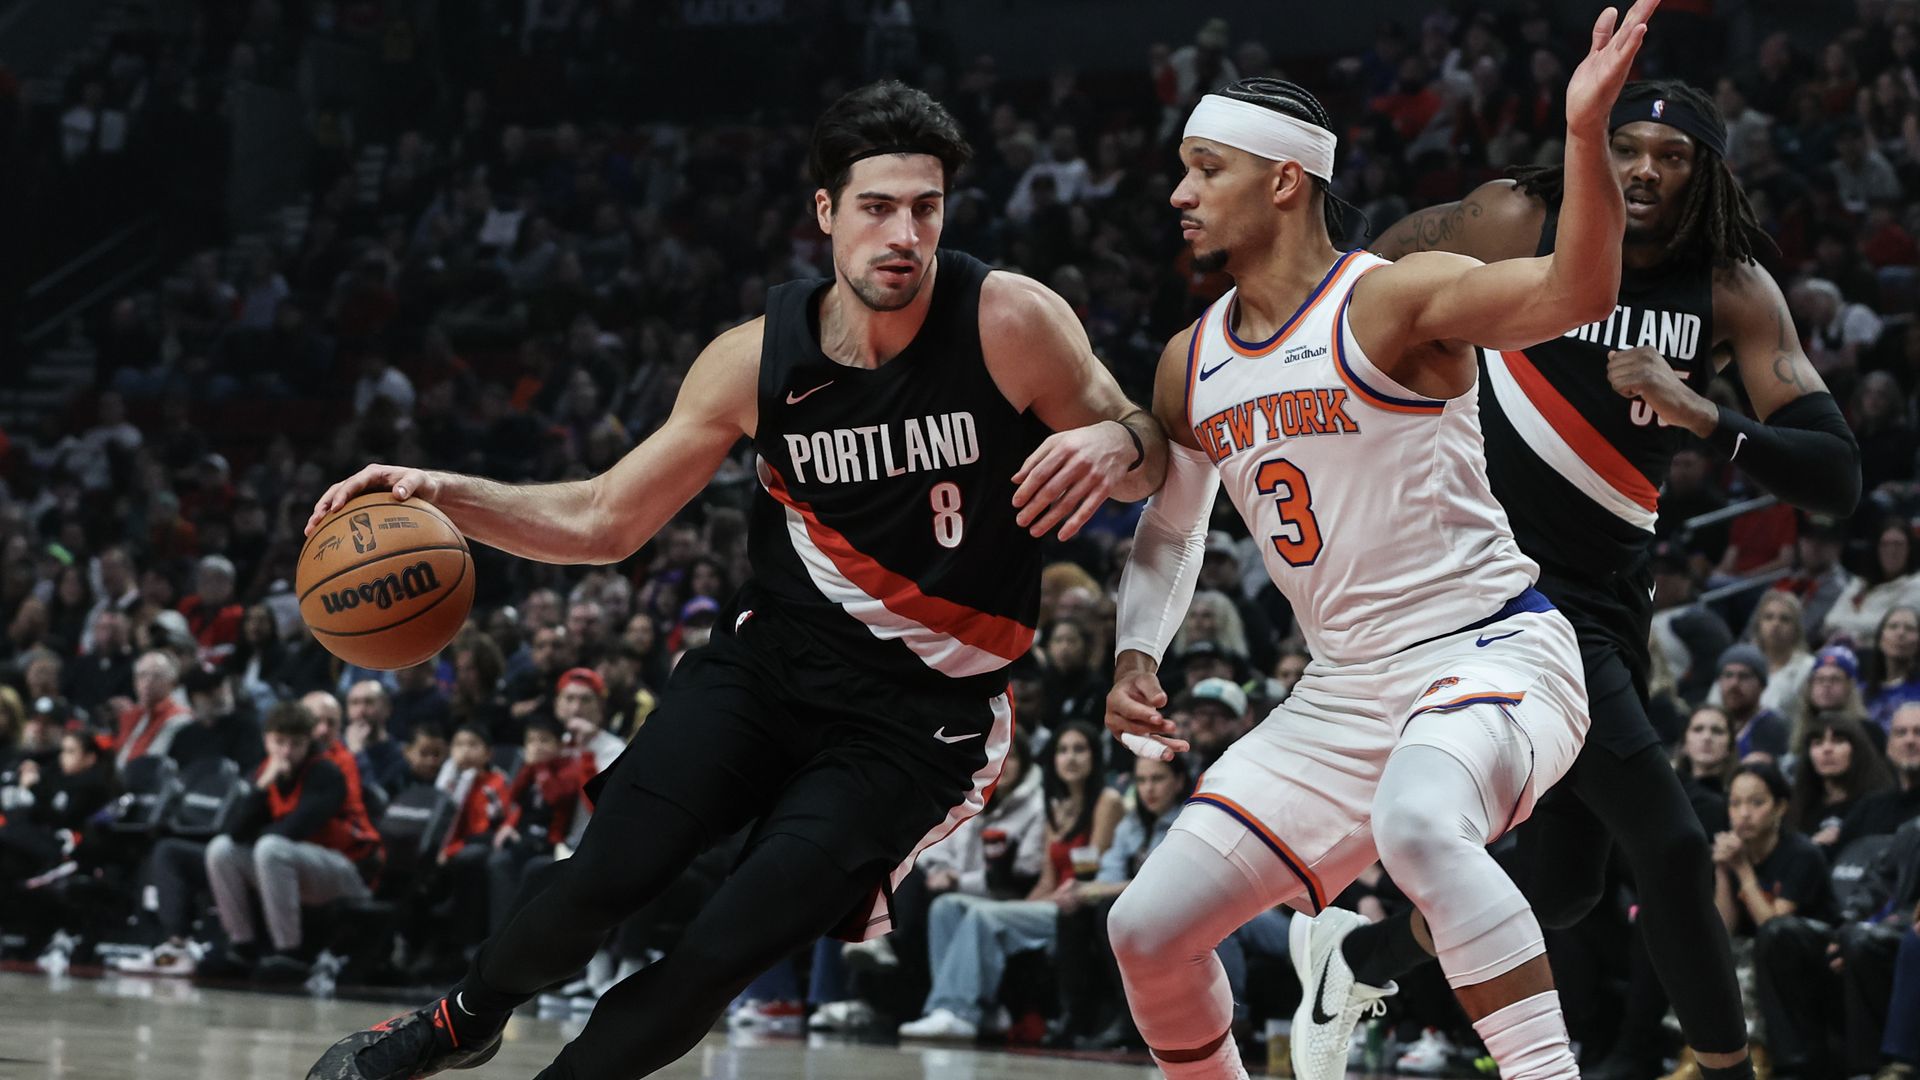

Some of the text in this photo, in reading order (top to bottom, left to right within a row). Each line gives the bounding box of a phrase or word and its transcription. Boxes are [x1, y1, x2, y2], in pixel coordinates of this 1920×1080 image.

[1284, 353, 1300, 364] abu
[1301, 345, 1327, 360] dhabi
[1564, 304, 1701, 361] TLAND
[783, 411, 980, 484] PORTLAND
[1194, 388, 1360, 467] NEW YORK
[929, 480, 964, 549] 8
[1255, 457, 1323, 568] 3
[321, 560, 441, 615] Wilson
